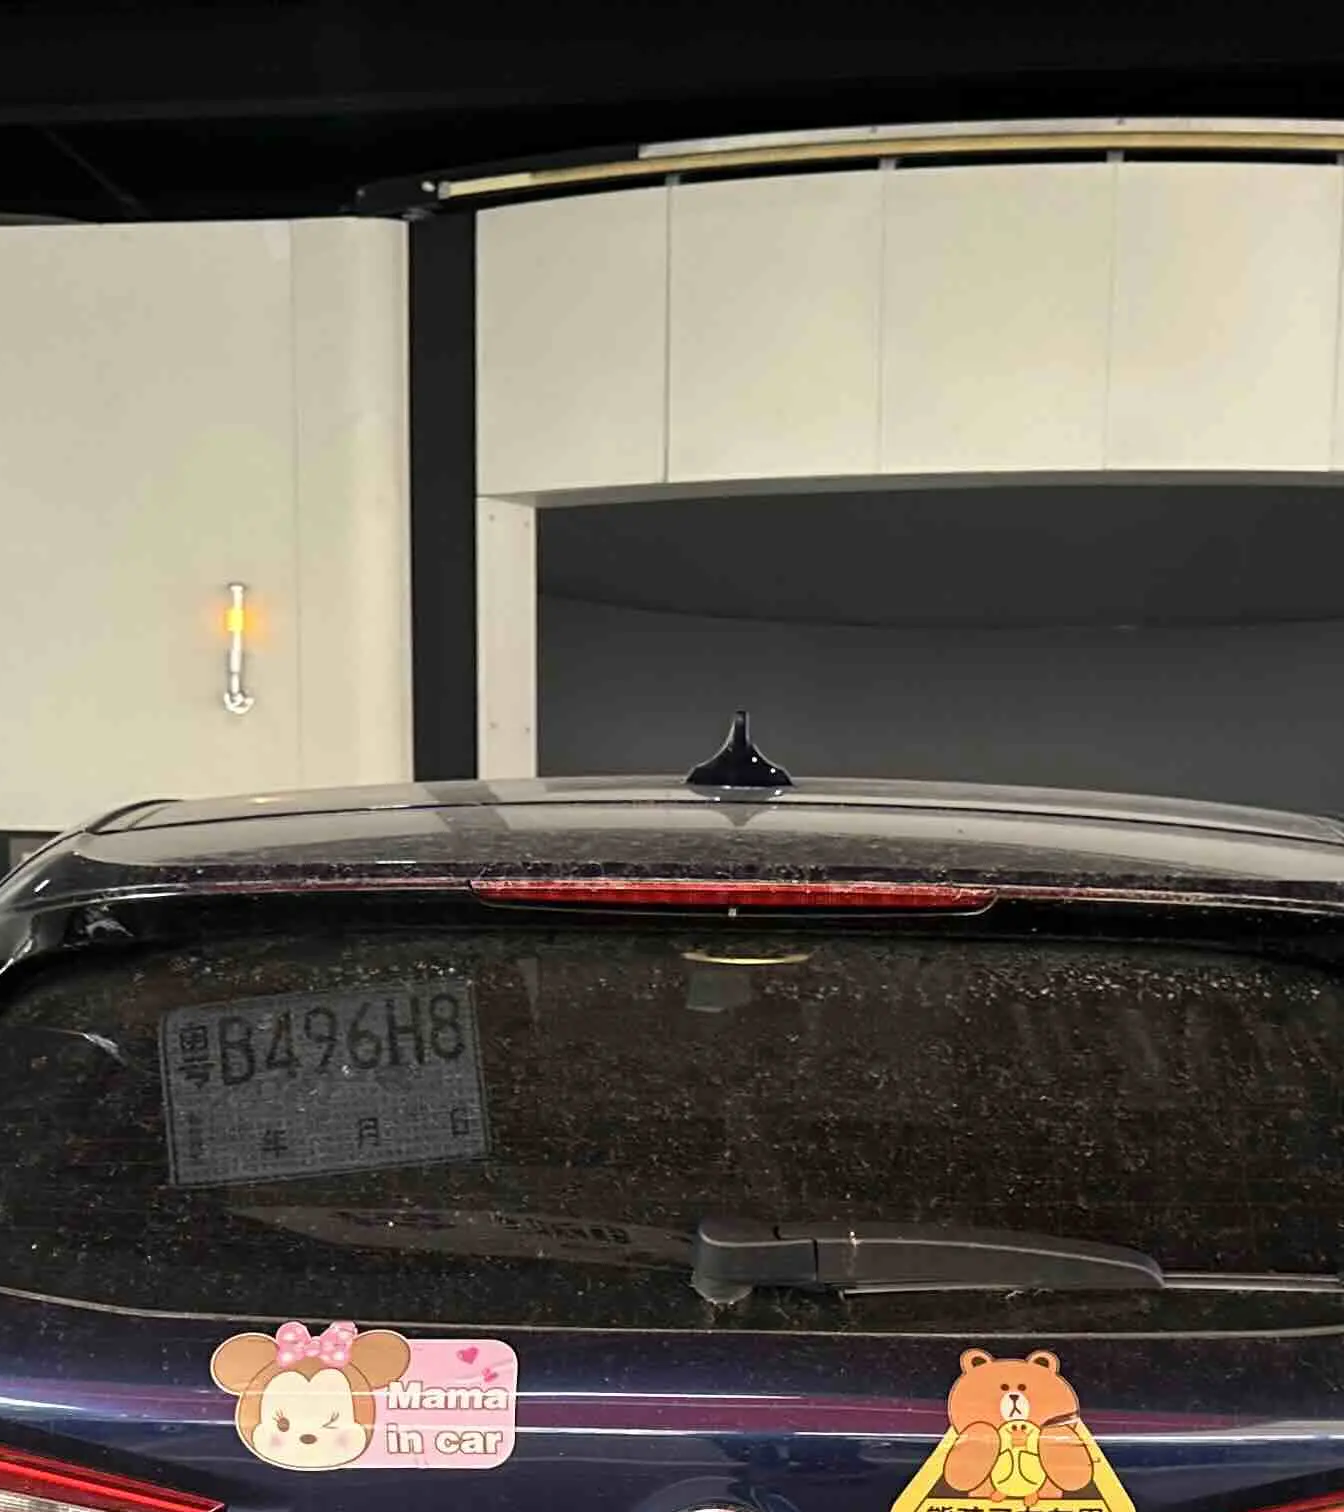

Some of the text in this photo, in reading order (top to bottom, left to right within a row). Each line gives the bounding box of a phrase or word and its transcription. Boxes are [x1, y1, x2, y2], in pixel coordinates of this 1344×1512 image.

[387, 1380, 509, 1410] Mama
[386, 1422, 503, 1455] in car
